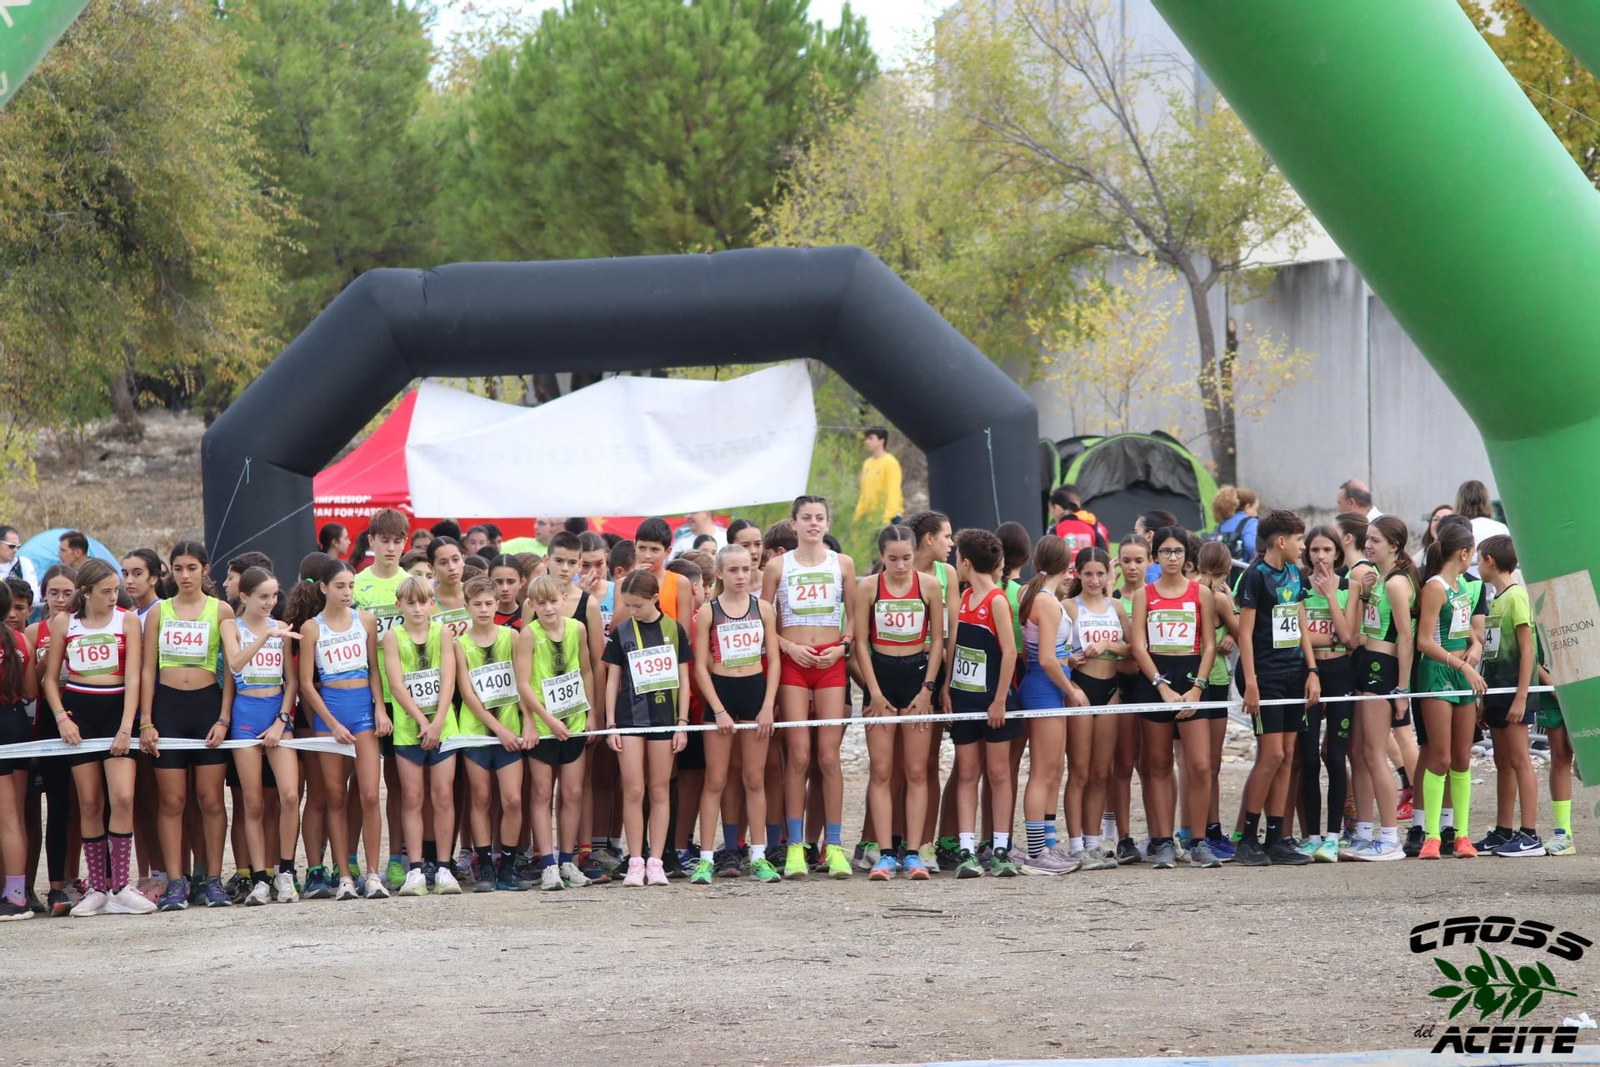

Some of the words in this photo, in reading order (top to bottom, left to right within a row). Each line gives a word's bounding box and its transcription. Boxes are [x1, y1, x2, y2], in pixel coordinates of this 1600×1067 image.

[796, 584, 827, 601] 241
[884, 612, 915, 628] 301
[1280, 617, 1298, 632] 46
[1546, 619, 1594, 638] DIPUTACIÓN
[164, 630, 203, 646] 1544
[1084, 630, 1119, 643] 1098
[1156, 622, 1188, 638] 172
[723, 631, 760, 649] 1504
[77, 644, 110, 662] 169
[325, 643, 361, 664] 1100
[634, 656, 672, 675] 1399
[956, 660, 979, 677] 307
[406, 680, 440, 698] 1386
[476, 672, 511, 692] 1400
[548, 681, 580, 703] 1387
